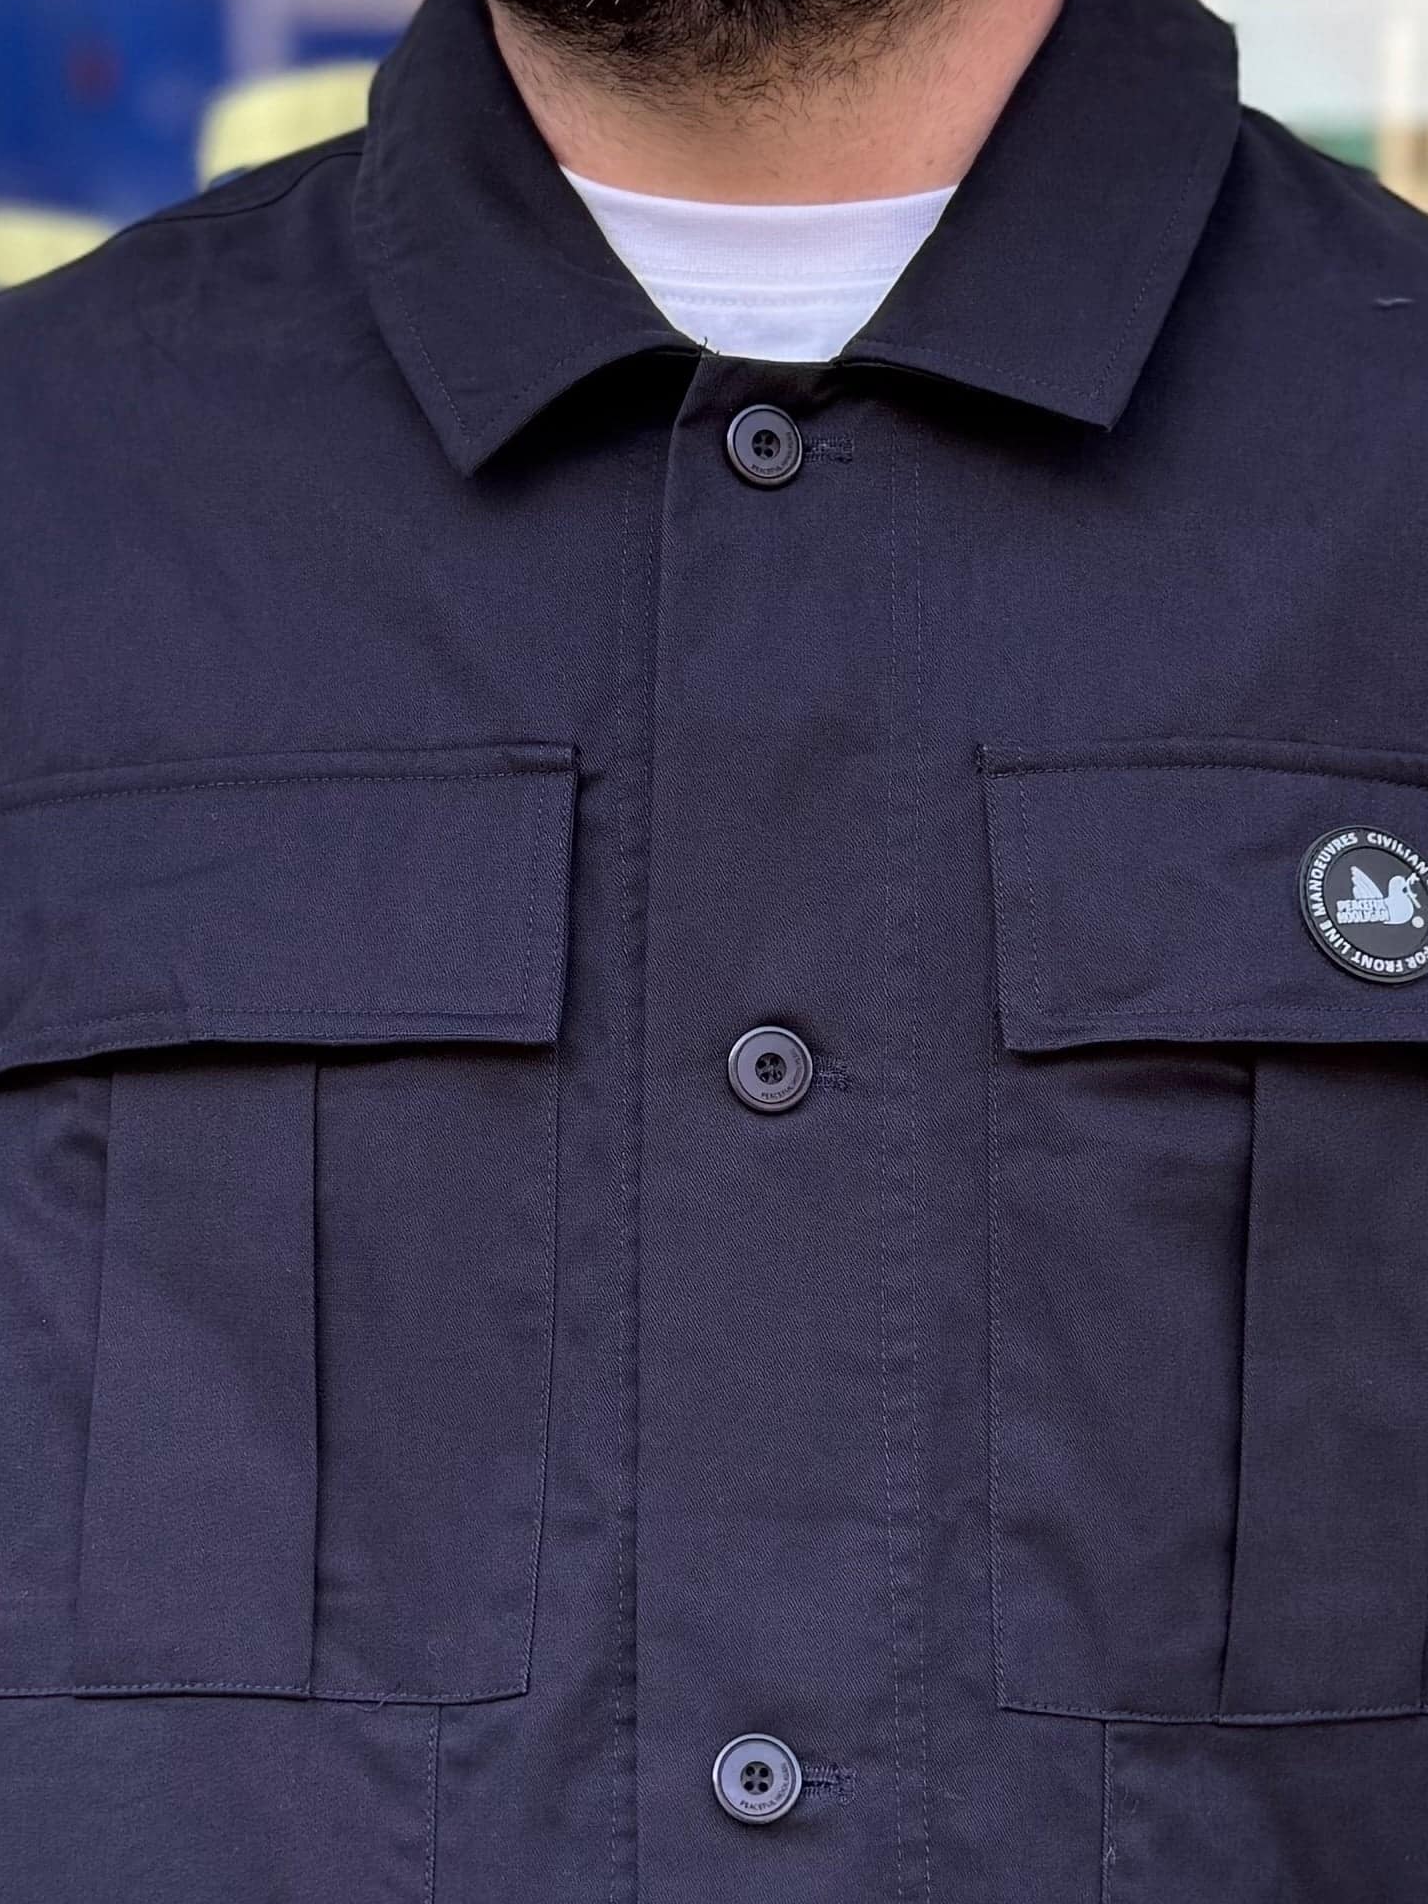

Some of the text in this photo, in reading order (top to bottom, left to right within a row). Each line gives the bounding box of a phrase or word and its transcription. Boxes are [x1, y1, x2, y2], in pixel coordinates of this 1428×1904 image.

[1367, 832, 1428, 876] CIVILIAN
[1308, 832, 1358, 917] MANOEUVRES
[1319, 920, 1352, 954] LINE
[1350, 951, 1404, 973] FRONT
